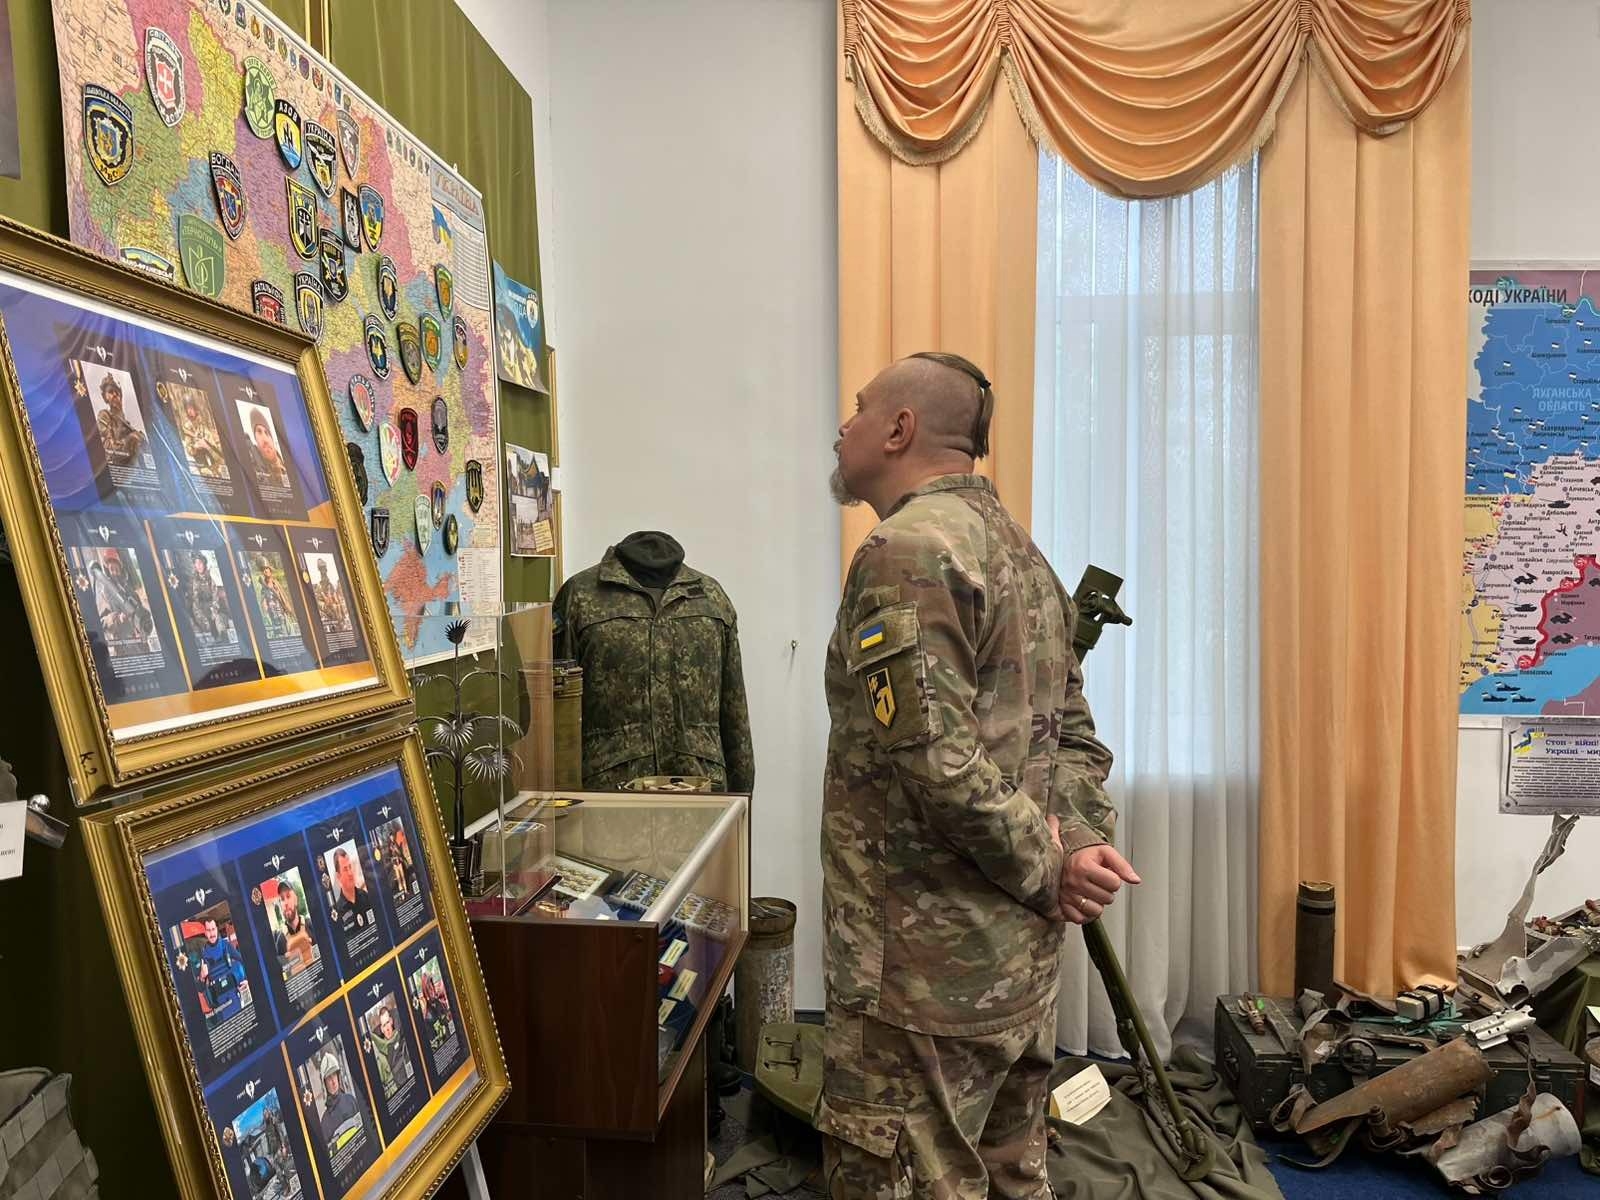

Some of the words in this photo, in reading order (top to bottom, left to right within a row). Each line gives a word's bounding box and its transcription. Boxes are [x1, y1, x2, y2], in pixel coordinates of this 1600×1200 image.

[279, 102, 300, 121] АЗОВ
[306, 124, 335, 146] УКРАЇНА
[211, 153, 241, 180] БОГДАН
[298, 276, 322, 295] УКРАЇНА
[1504, 285, 1567, 304] УКРАЇНИ
[1532, 387, 1592, 399] ЛУГАНСЬКА
[1538, 400, 1586, 412] ОБЛАСТЬ
[1483, 561, 1514, 571] Донецьк
[1545, 747, 1578, 756] Україні
